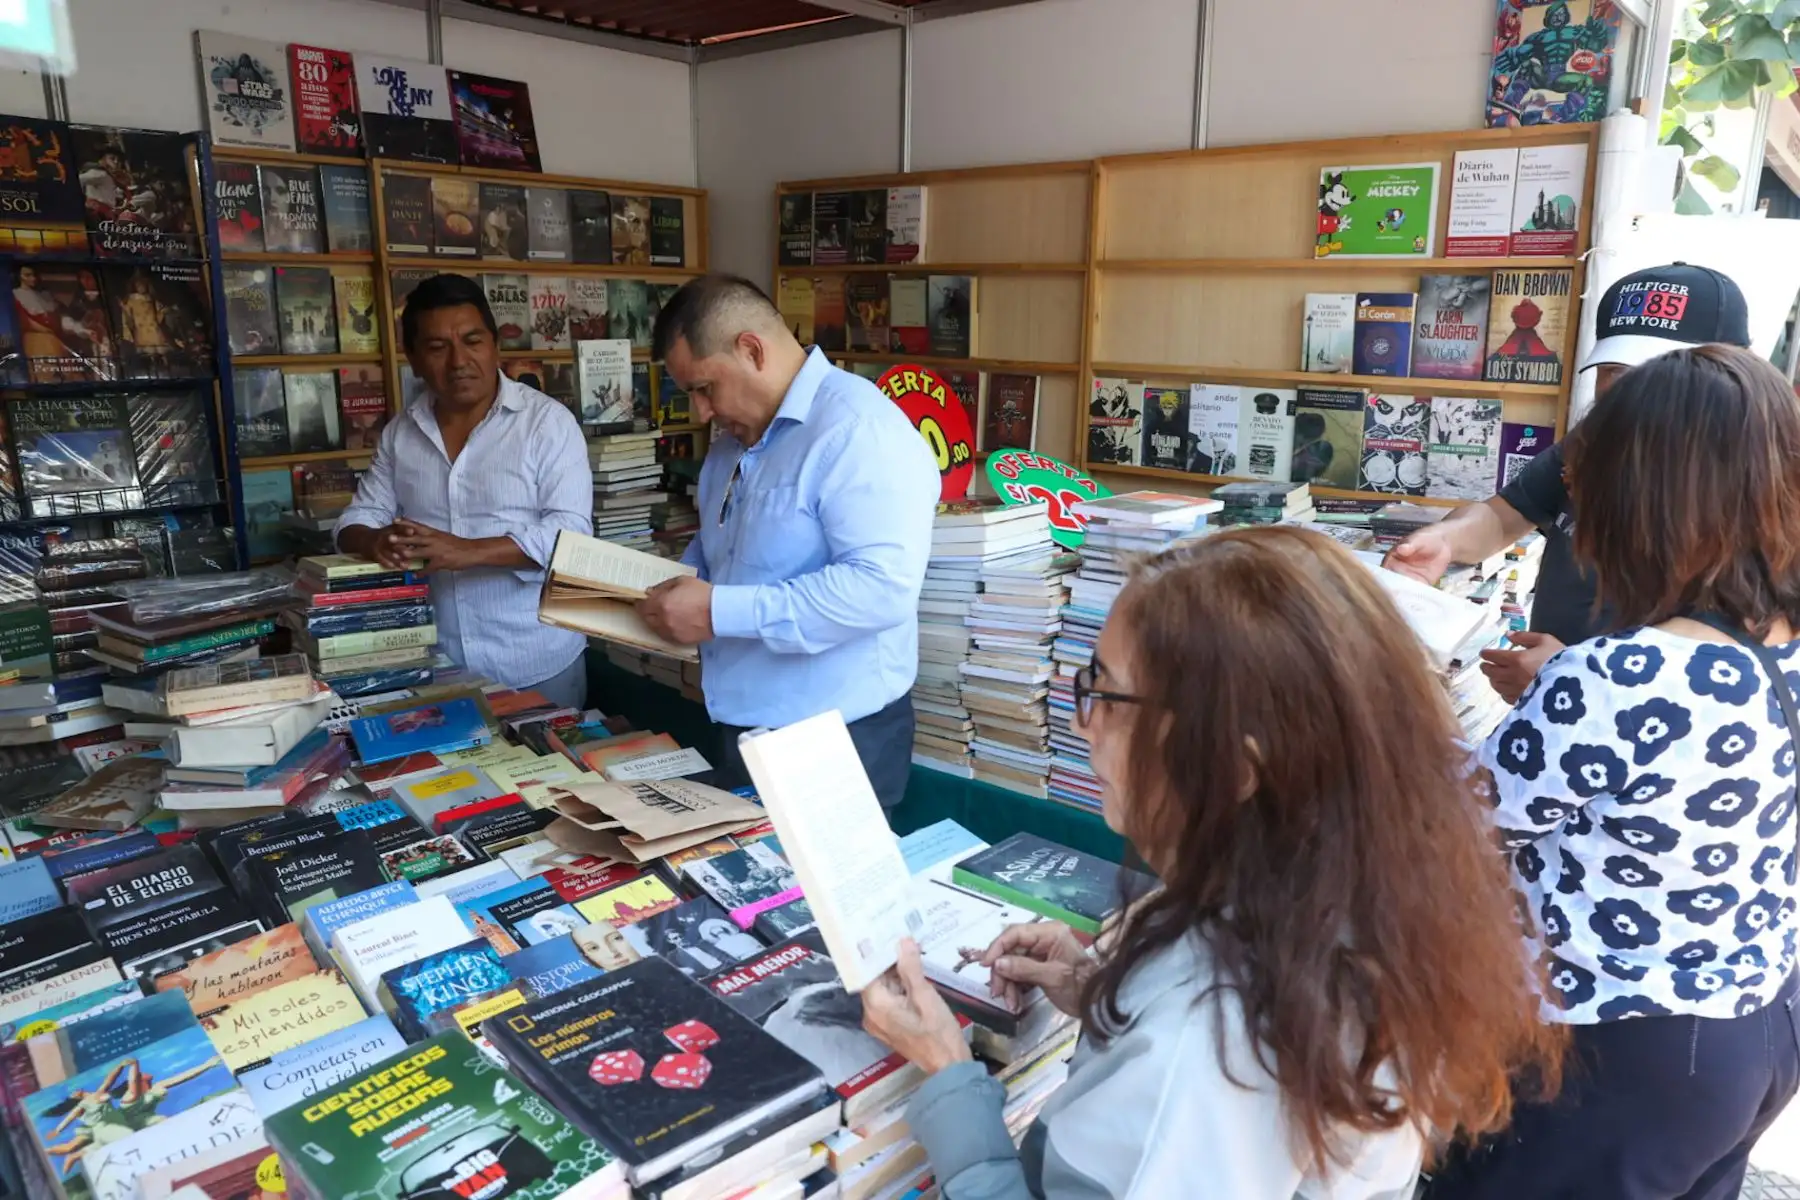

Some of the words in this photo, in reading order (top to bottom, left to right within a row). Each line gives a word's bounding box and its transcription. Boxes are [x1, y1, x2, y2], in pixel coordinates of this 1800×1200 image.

[297, 49, 326, 63] MARVEL
[298, 62, 328, 82] 80
[373, 66, 408, 86] LOVE
[240, 80, 270, 90] STAR
[301, 81, 329, 92] años
[410, 86, 433, 106] MY
[1459, 160, 1494, 171] Diario
[288, 179, 311, 193] BLUE
[1457, 172, 1470, 183] de
[1472, 171, 1510, 183] Wuhan
[1367, 185, 1420, 198] MICKEY
[3, 198, 42, 214] SOL
[99, 220, 150, 237] Fiestas
[1494, 273, 1520, 296] DAN
[1523, 273, 1570, 296] BROWN
[1620, 281, 1689, 296] HILFIGER
[489, 289, 528, 303] SALAS
[531, 295, 566, 310] 1707
[1614, 292, 1684, 317] 1985
[1358, 309, 1365, 318] El
[1368, 309, 1396, 320] Corán
[1436, 309, 1464, 323] KARIN
[1609, 316, 1638, 328] NEW
[1641, 316, 1680, 331] YORK
[1420, 323, 1478, 341] SLAUGHTER
[1487, 361, 1514, 380] LOST
[1515, 362, 1559, 382] SYMBOL
[881, 371, 946, 407] ERTA
[1214, 393, 1238, 401] andar
[17, 400, 36, 410] LA
[37, 399, 113, 411] HACIENDA
[1208, 430, 1233, 440] gente
[1217, 421, 1238, 429] entre
[993, 451, 1098, 496] OFERTA
[1003, 482, 1029, 504] S/
[343, 806, 396, 828] UEDAS
[247, 838, 296, 857] Benjamin
[298, 830, 326, 844] Black
[275, 861, 298, 878] Joël
[300, 851, 338, 869] Dicker
[279, 876, 292, 886] La
[293, 863, 344, 883] desaparición
[344, 859, 355, 867] de
[106, 882, 128, 897] EL
[131, 865, 189, 890] DIARIO
[283, 877, 326, 893] Stephanie
[326, 867, 353, 881] Mailer
[575, 884, 587, 892] de
[112, 895, 136, 908] DE
[142, 875, 195, 900] ELISEO
[318, 894, 368, 917] ALFREDO
[105, 921, 148, 939] Fernando
[149, 905, 191, 925] Aramburu
[110, 930, 144, 948] HIJOS
[144, 925, 161, 936] DE
[161, 920, 177, 931] LA
[178, 905, 220, 924] FÁBULA
[203, 974, 223, 989] las
[229, 945, 297, 980] montañas
[400, 951, 490, 993] STEPHEN
[716, 972, 753, 994] MAL
[751, 945, 809, 976] MENOR
[0, 989, 39, 1007] ABEL
[43, 960, 114, 991] ALLENDE
[217, 970, 284, 1000] hablaron
[420, 969, 490, 1006] KING
[531, 1000, 580, 1022] NATIONAL
[578, 978, 635, 1003] GEOGRAPHIC
[233, 1012, 261, 1034] Mil
[269, 991, 321, 1018] soles
[528, 1032, 557, 1048] Los
[555, 1008, 616, 1038] números
[540, 1033, 591, 1060] primos
[263, 1046, 358, 1091] Cometas
[361, 1037, 386, 1054] en
[302, 1044, 448, 1124] CIENTÍFICOS
[302, 1077, 319, 1099] el
[346, 1069, 433, 1120] SOBRE
[454, 1148, 499, 1179] BIG
[451, 1161, 508, 1200] VAN
